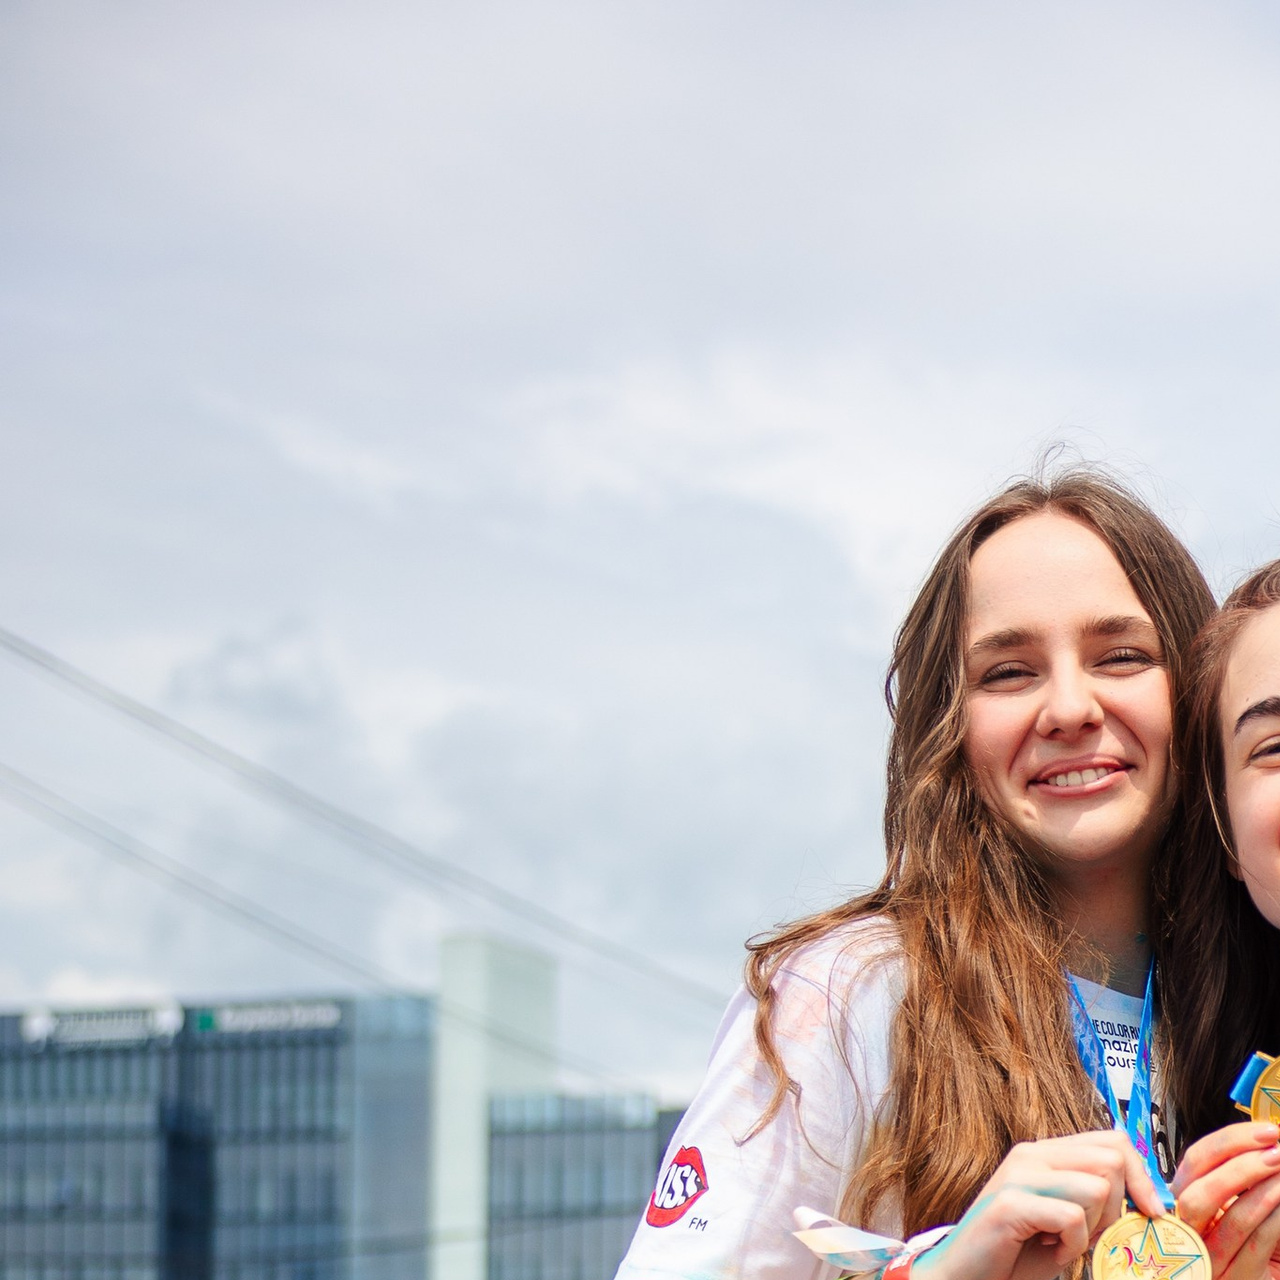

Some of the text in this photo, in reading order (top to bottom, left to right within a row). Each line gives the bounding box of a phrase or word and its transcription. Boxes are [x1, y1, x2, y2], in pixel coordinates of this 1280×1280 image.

[1101, 1021, 1131, 1039] COLOR
[1130, 1026, 1141, 1040] RU
[1099, 1037, 1140, 1055] mazin
[689, 1216, 709, 1232] FM
